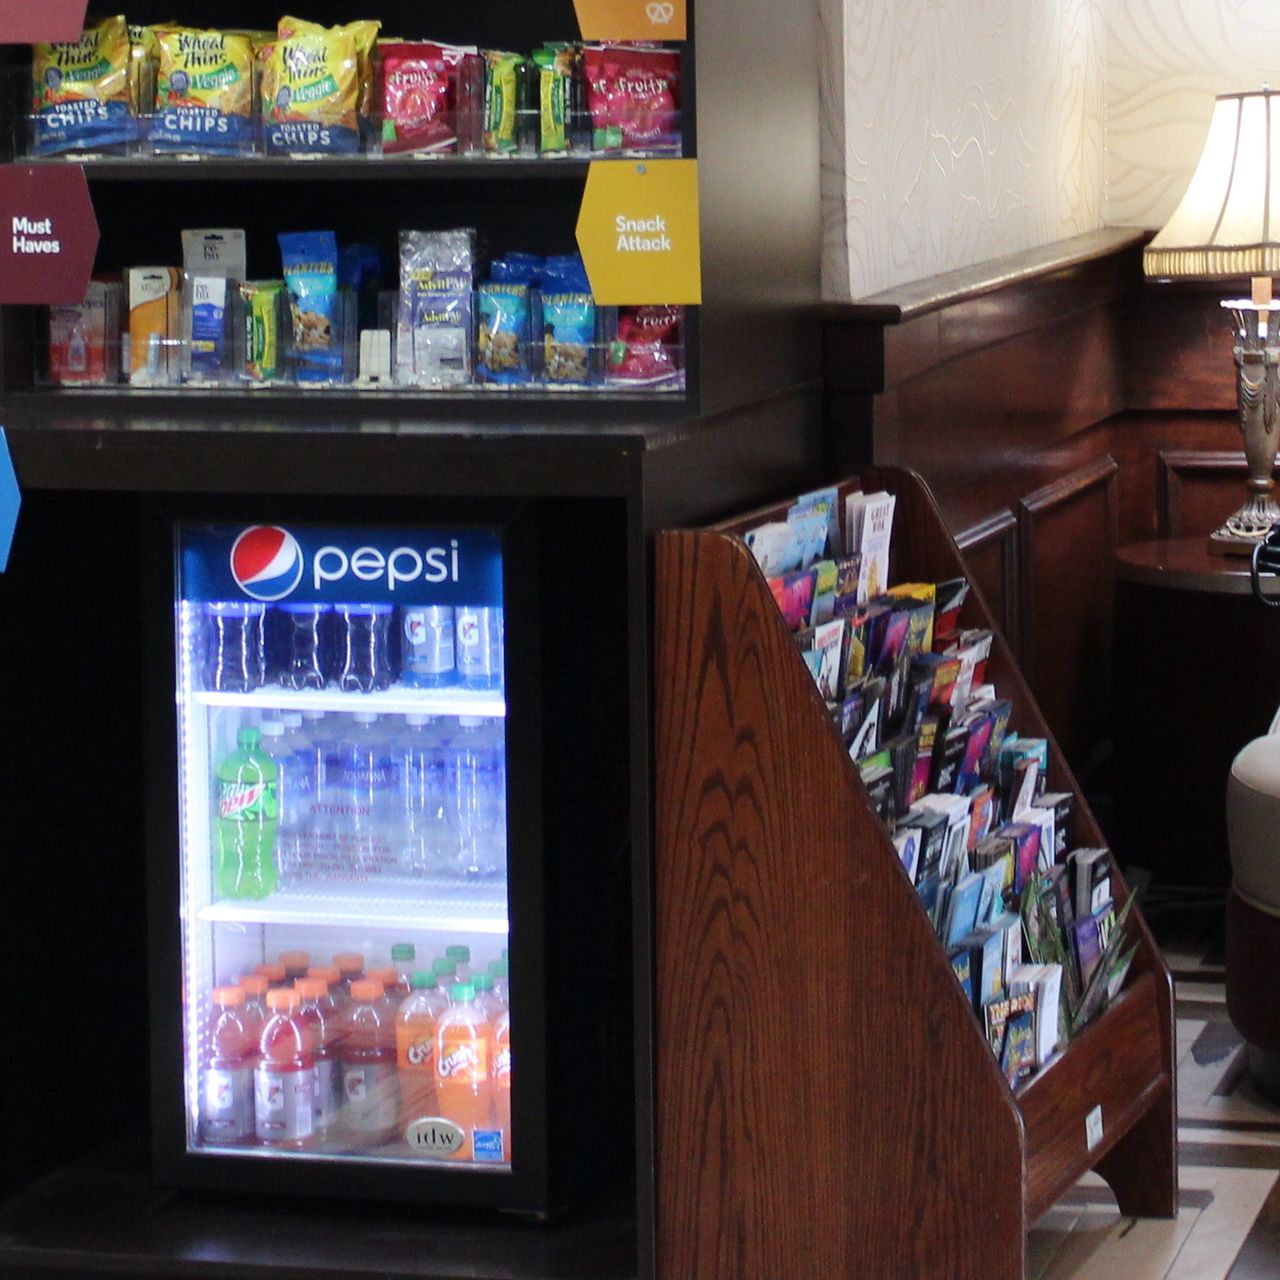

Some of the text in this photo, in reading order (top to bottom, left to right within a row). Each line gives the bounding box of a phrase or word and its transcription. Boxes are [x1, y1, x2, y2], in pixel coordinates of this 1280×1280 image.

[178, 32, 226, 52] Wheat
[183, 51, 227, 68] Thins
[195, 68, 236, 89] Veggie
[294, 83, 332, 103] Veggie
[55, 99, 98, 113] TOASTED
[176, 106, 219, 118] TOASTED
[46, 106, 109, 128] CHIPS
[165, 115, 229, 133] CHIPS
[280, 123, 319, 132] TOASTED
[272, 130, 331, 146] CHIPS
[12, 216, 52, 234] Must
[616, 215, 666, 232] Snack
[13, 236, 60, 253] Haves
[617, 234, 671, 251] Attack
[313, 539, 459, 592] pepsi
[405, 612, 426, 646] G
[457, 613, 479, 646] G
[416, 1127, 454, 1145] idw
